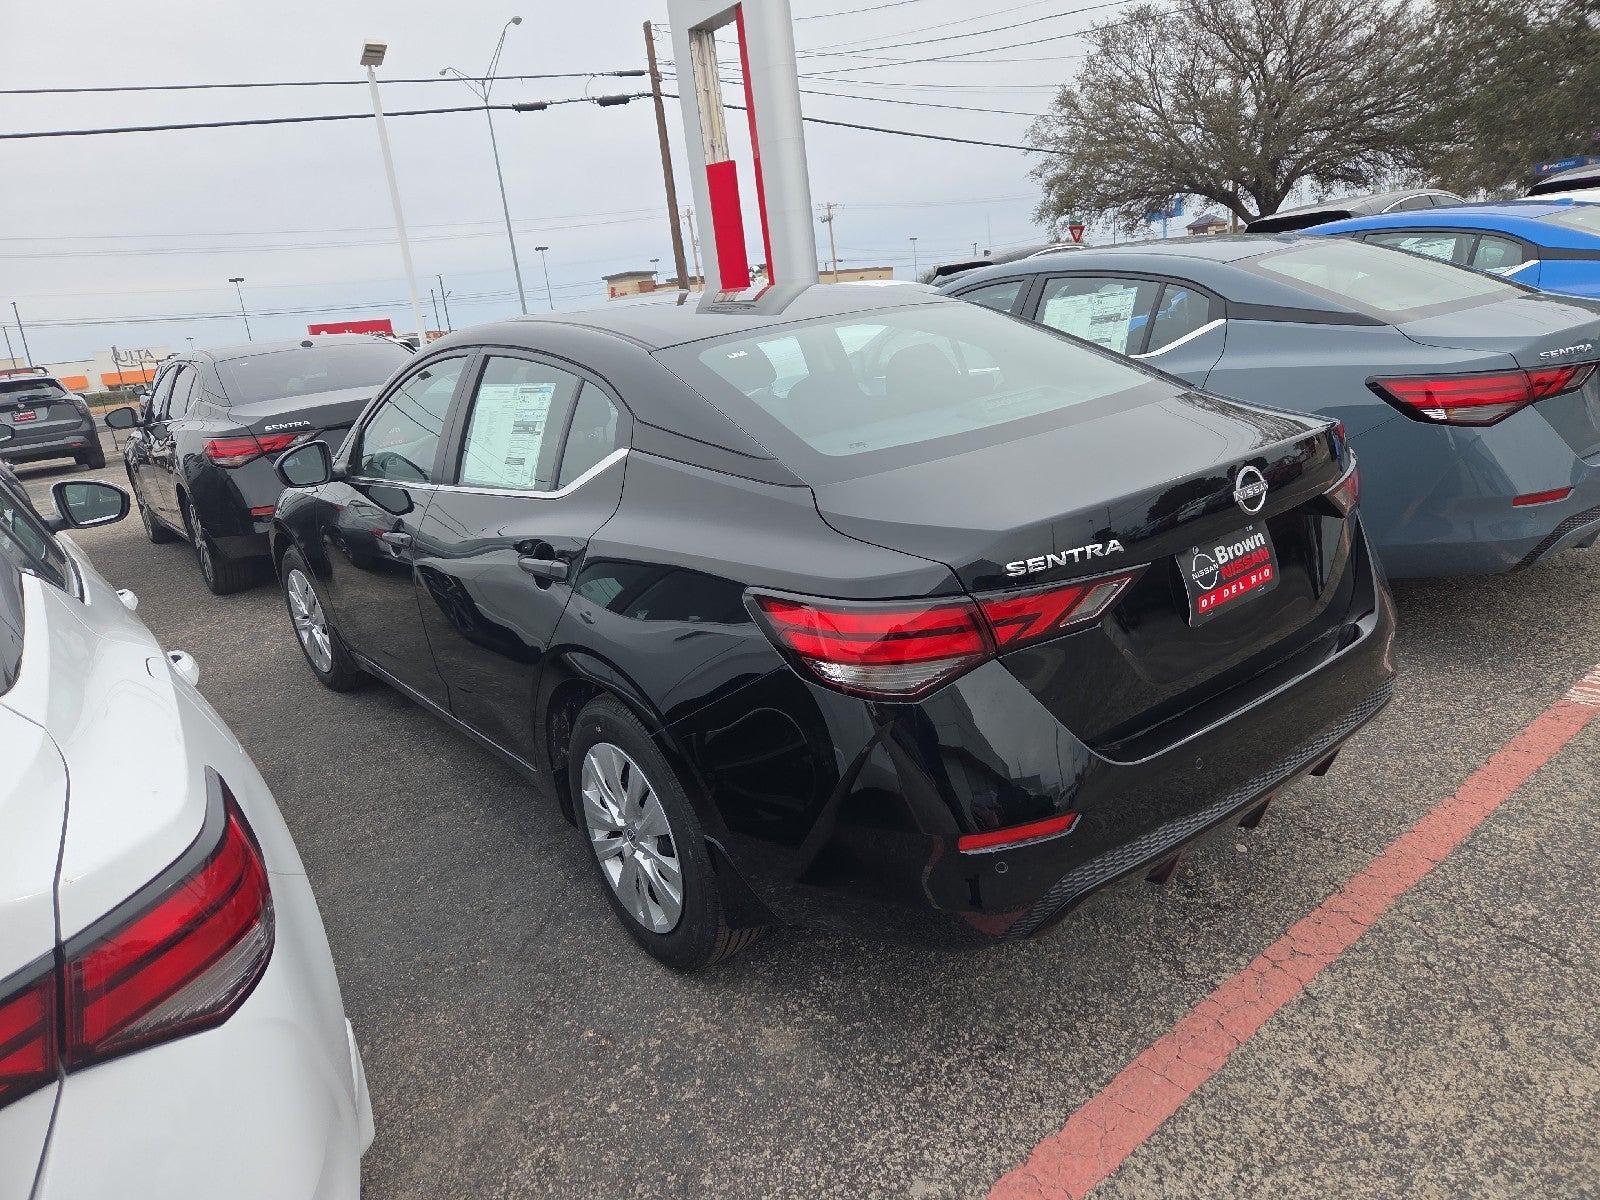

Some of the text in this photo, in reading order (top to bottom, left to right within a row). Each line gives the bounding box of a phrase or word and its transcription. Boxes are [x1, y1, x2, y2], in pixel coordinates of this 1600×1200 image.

[116, 349, 154, 362] ULTA
[1539, 343, 1593, 360] SENTRA
[264, 420, 310, 431] SENTRA
[1235, 483, 1268, 499] NISSAN
[1215, 532, 1265, 564] Brown
[1005, 539, 1125, 577] SENTRA
[1221, 547, 1270, 580] NISSAN
[1192, 563, 1219, 579] NISSAN
[1201, 568, 1270, 608] OF DEL RIO
